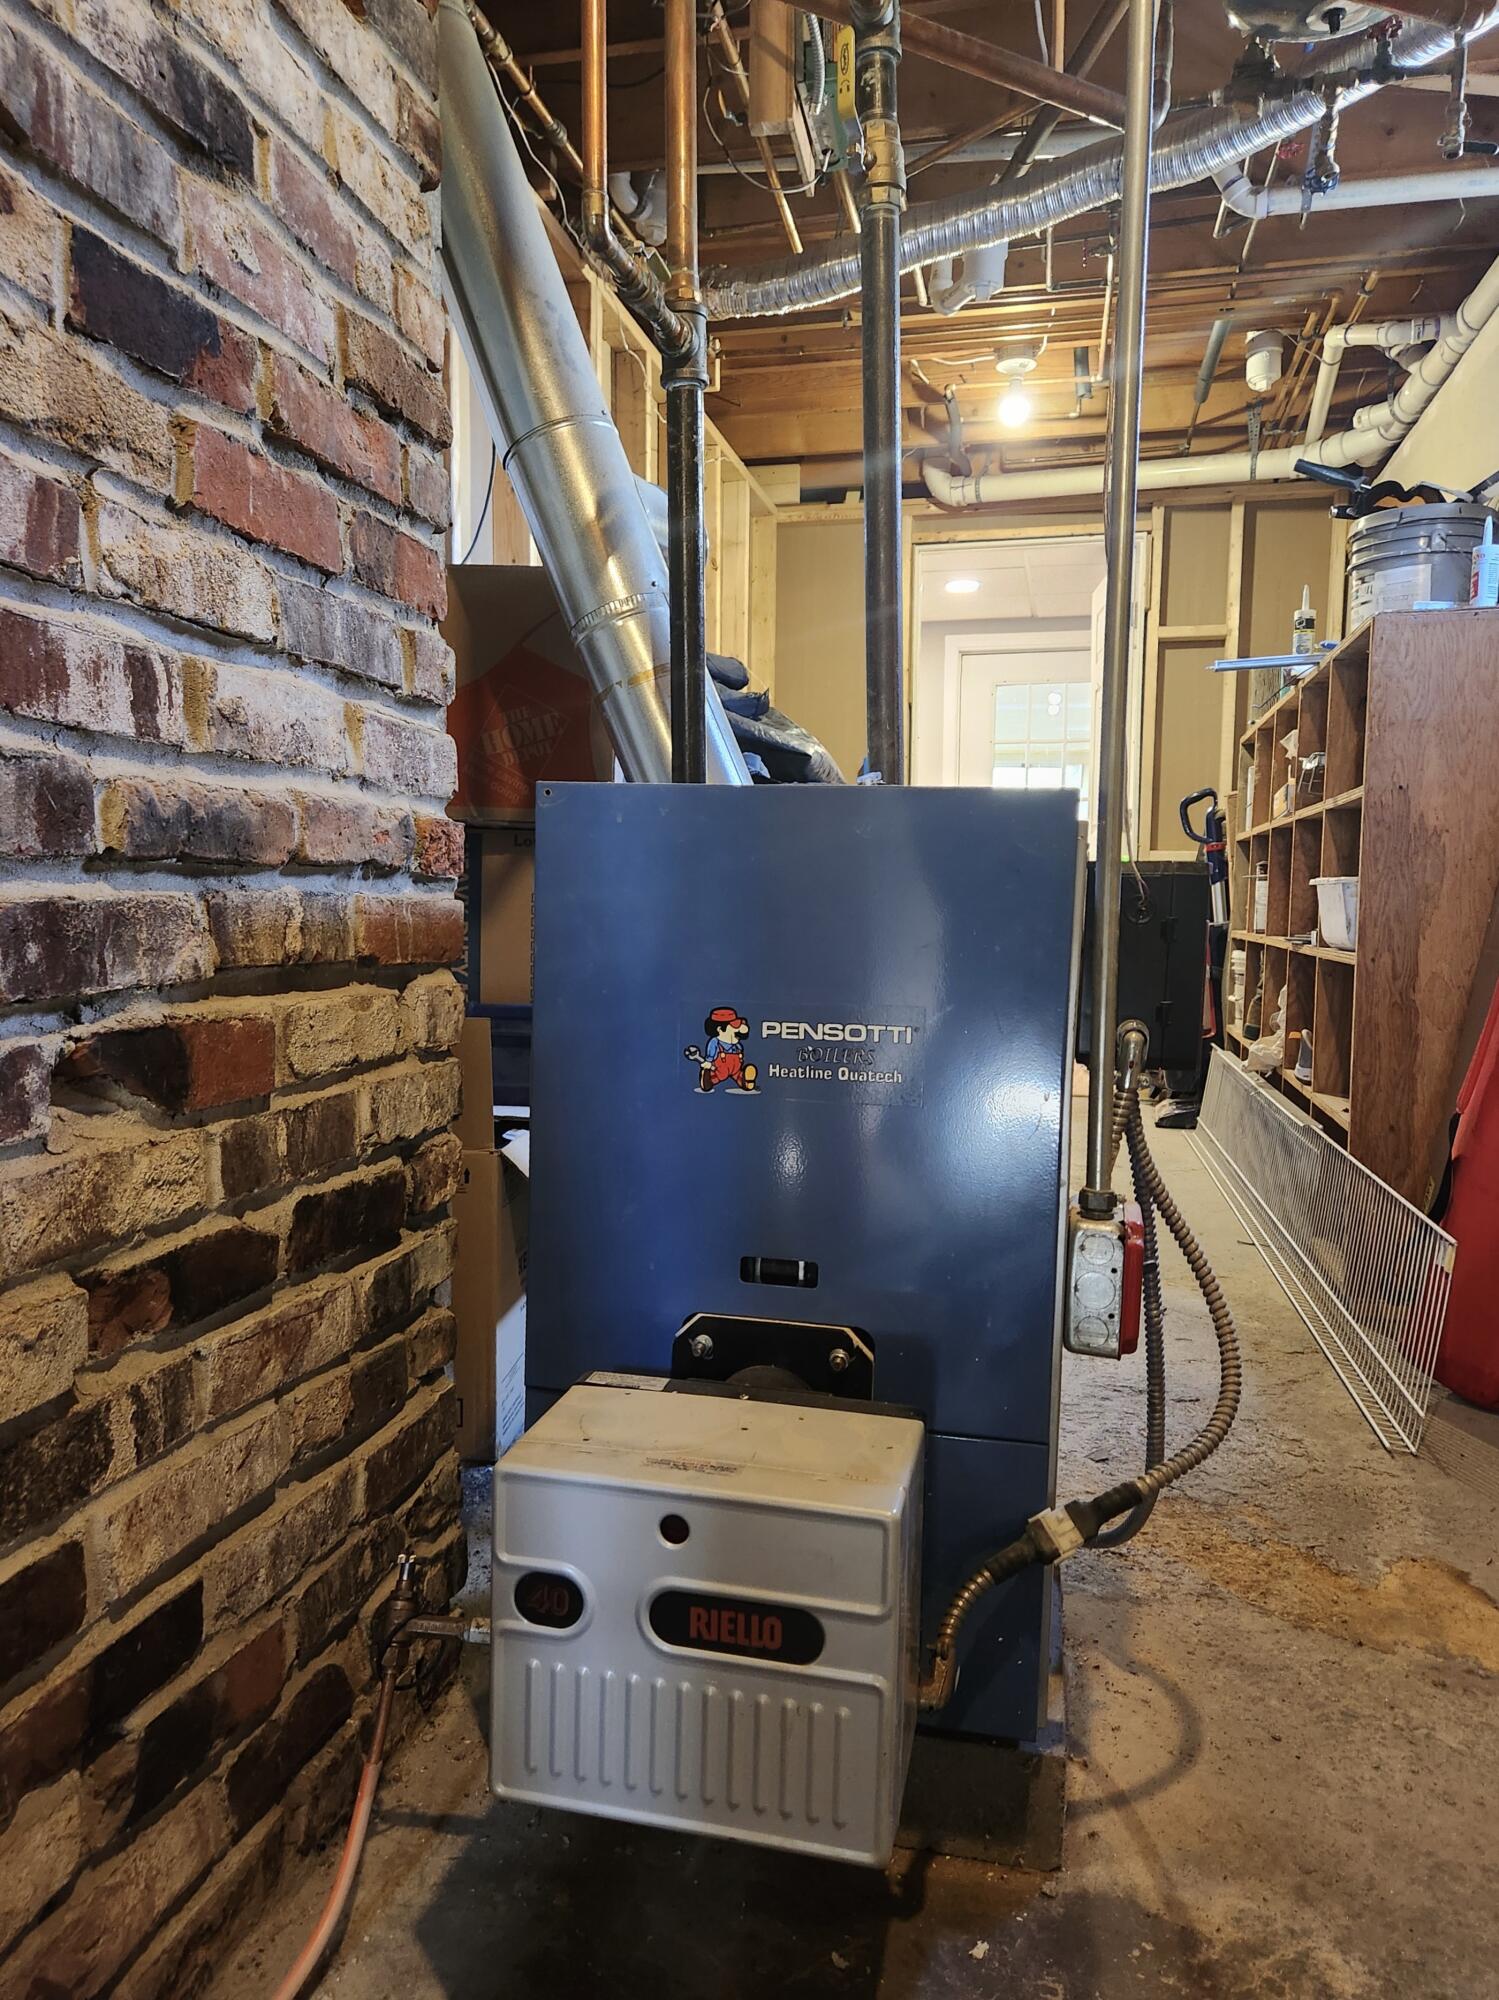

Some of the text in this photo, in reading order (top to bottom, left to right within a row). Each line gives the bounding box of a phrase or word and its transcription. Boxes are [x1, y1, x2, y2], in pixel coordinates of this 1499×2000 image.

[480, 712, 560, 753] HOME
[761, 1021, 913, 1044] PENSOTTI
[769, 1064, 902, 1083] Heatline Quatech
[528, 1584, 570, 1618] 40
[689, 1606, 783, 1650] RIELLO
